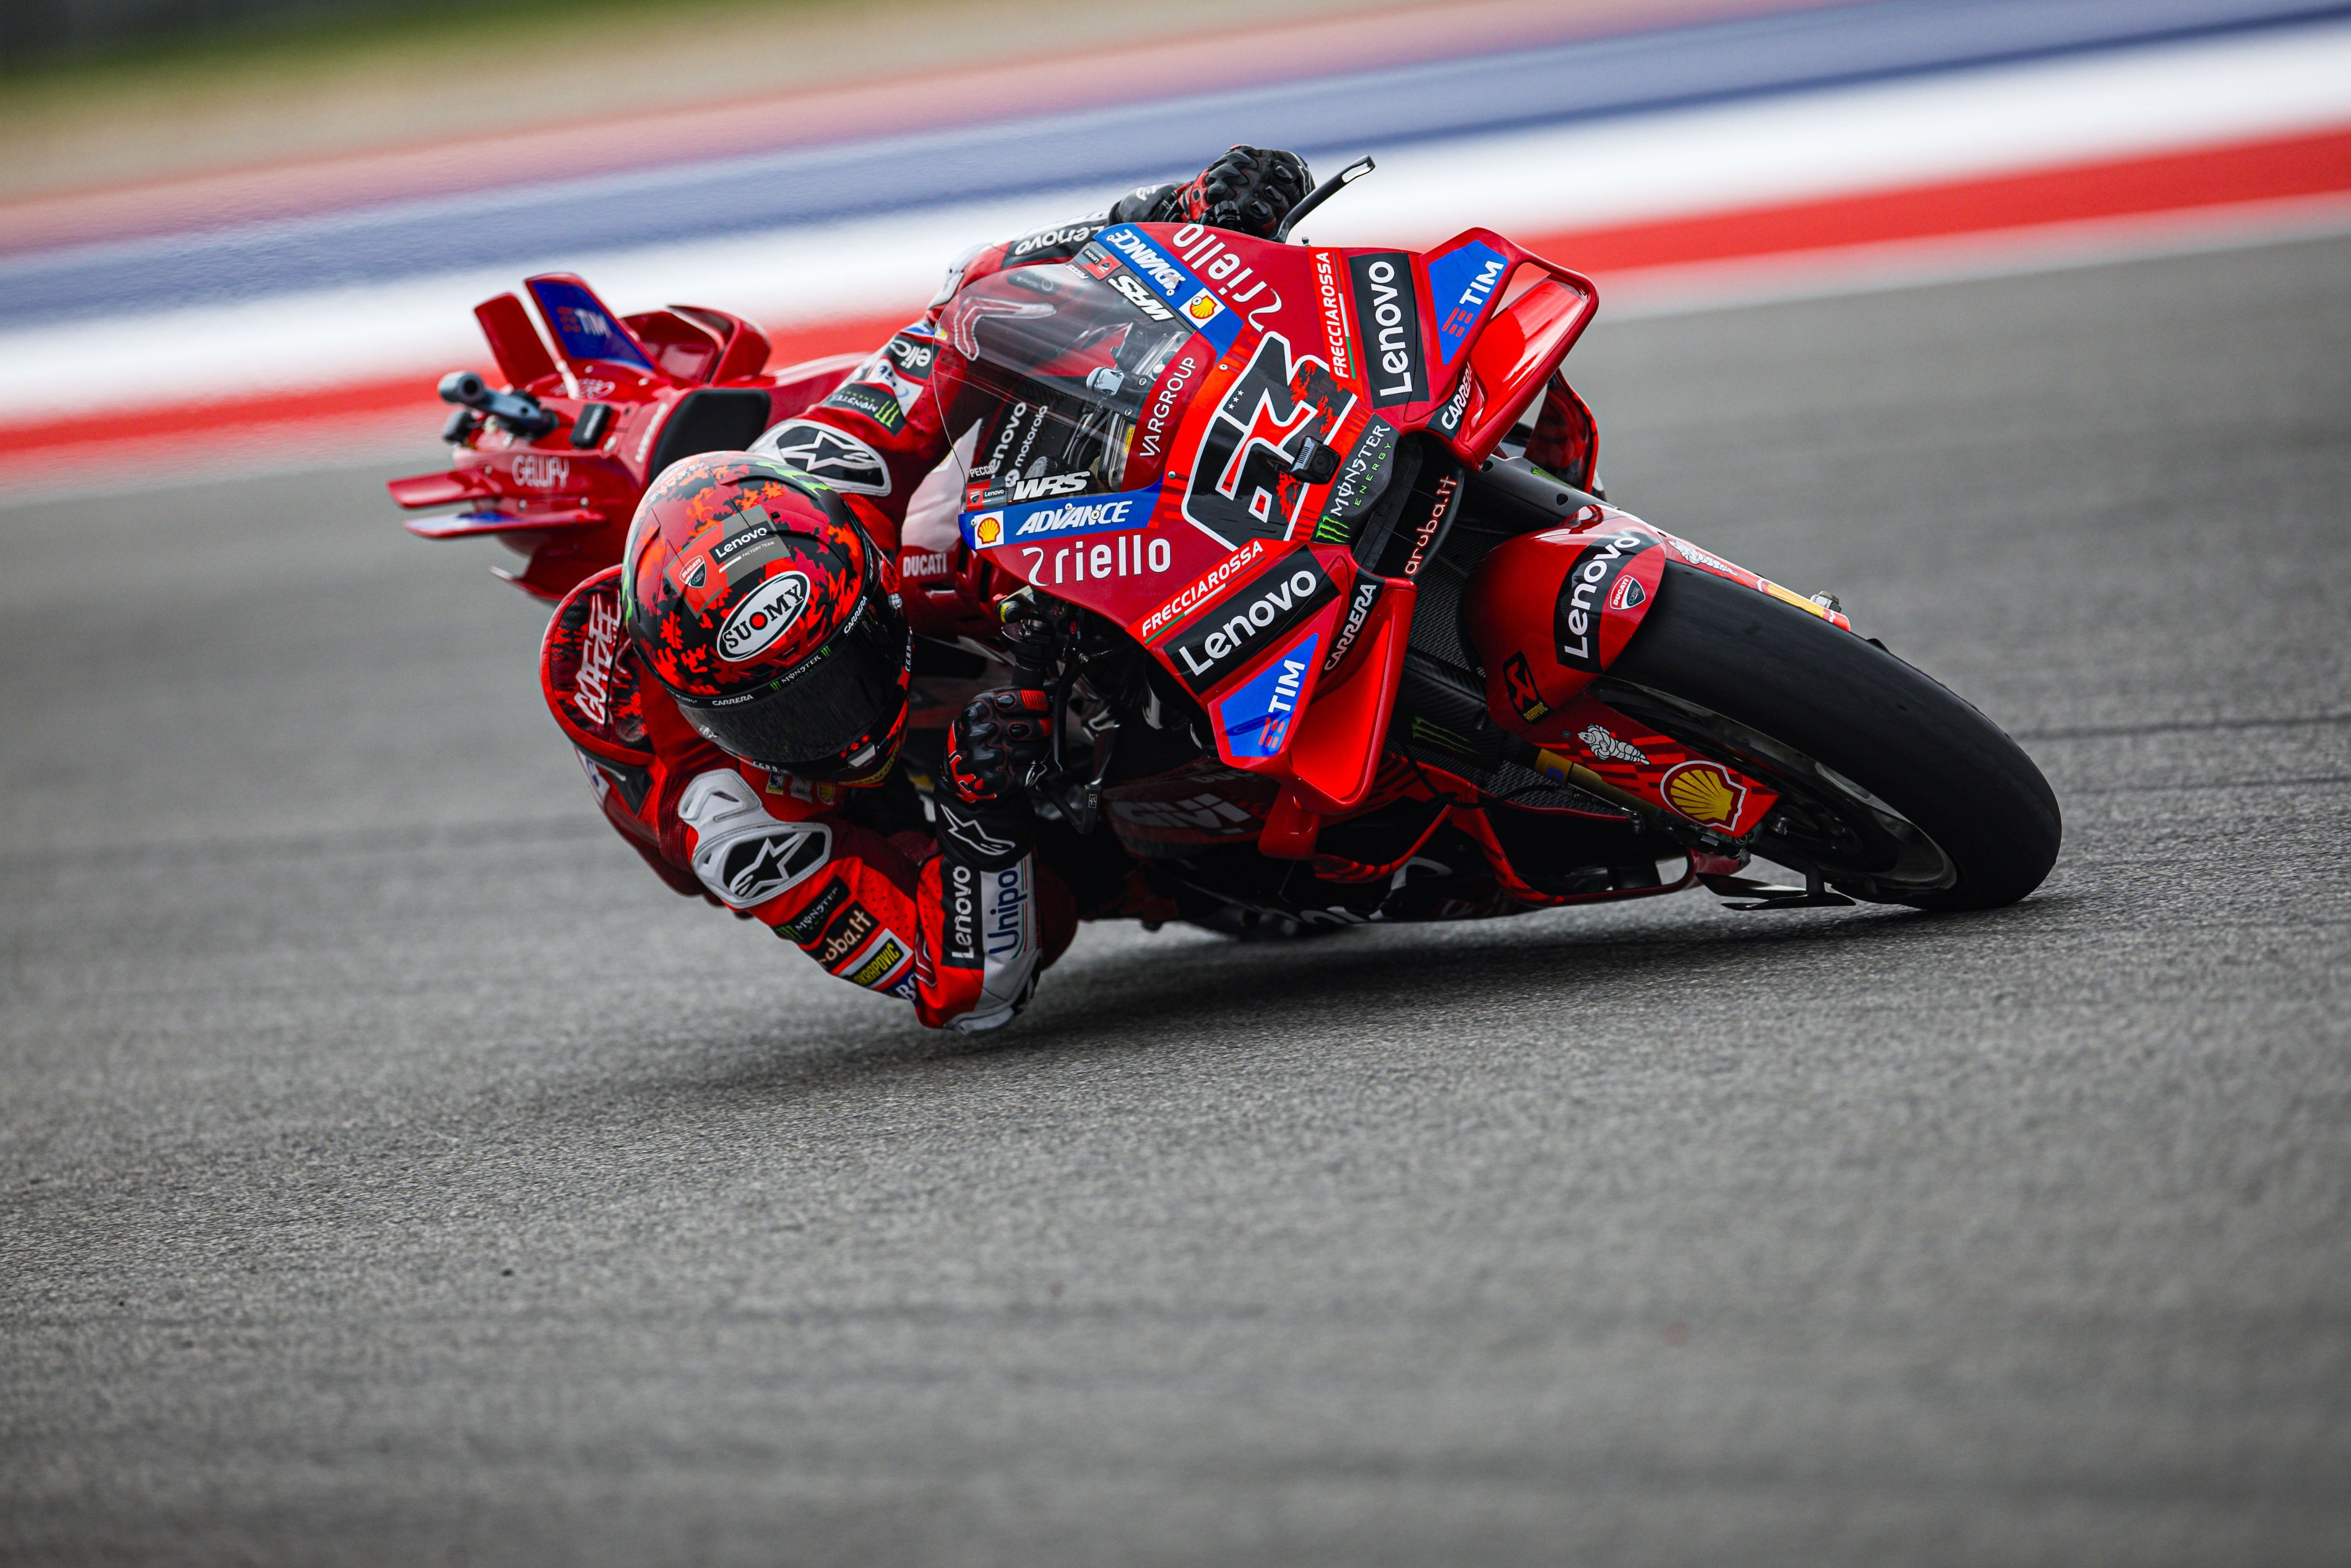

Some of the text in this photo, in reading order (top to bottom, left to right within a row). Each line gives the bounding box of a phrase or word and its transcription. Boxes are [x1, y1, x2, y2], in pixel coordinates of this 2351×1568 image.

[1014, 224, 1105, 256] Lenovo
[1114, 228, 1187, 290] ADVANCE
[1172, 223, 1267, 303] riello
[1107, 275, 1174, 322] WRS
[1460, 261, 1504, 306] TIM
[1322, 251, 1349, 379] FRECCIAROSSA
[1368, 261, 1413, 397] Lenovo
[1139, 357, 1197, 457] VARGROUP
[1441, 362, 1474, 430] CARRERA
[988, 402, 1027, 479] enovo
[1015, 405, 1048, 467] motorola
[1181, 331, 1358, 552] 63
[984, 489, 1004, 497] Lenovo
[1013, 471, 1091, 500] WRS
[1330, 424, 1390, 516] MONSTER
[1354, 441, 1392, 506] ENERGY
[715, 527, 767, 559] Lenovo
[1015, 500, 1134, 535] ADVANCE
[1404, 474, 1459, 577] aruba.it
[682, 557, 701, 579] DUCATI
[742, 546, 761, 557] FACTORY
[902, 552, 948, 578] DUCATI
[1054, 534, 1171, 584] riello
[720, 580, 804, 651] SUOMY
[843, 595, 868, 634] CARRERA
[1141, 540, 1264, 638] FRECCIAROSSA
[1564, 537, 1641, 659] Lenovo
[1613, 577, 1629, 606] DUCATI
[1628, 585, 1640, 605] CORSE
[1178, 570, 1317, 677] Lenovo
[1324, 583, 1377, 672] CARRERA
[712, 694, 754, 705] CARRERA
[781, 655, 822, 684] MONSTER
[1268, 658, 1305, 713] TIM
[951, 865, 974, 959] Lenovo
